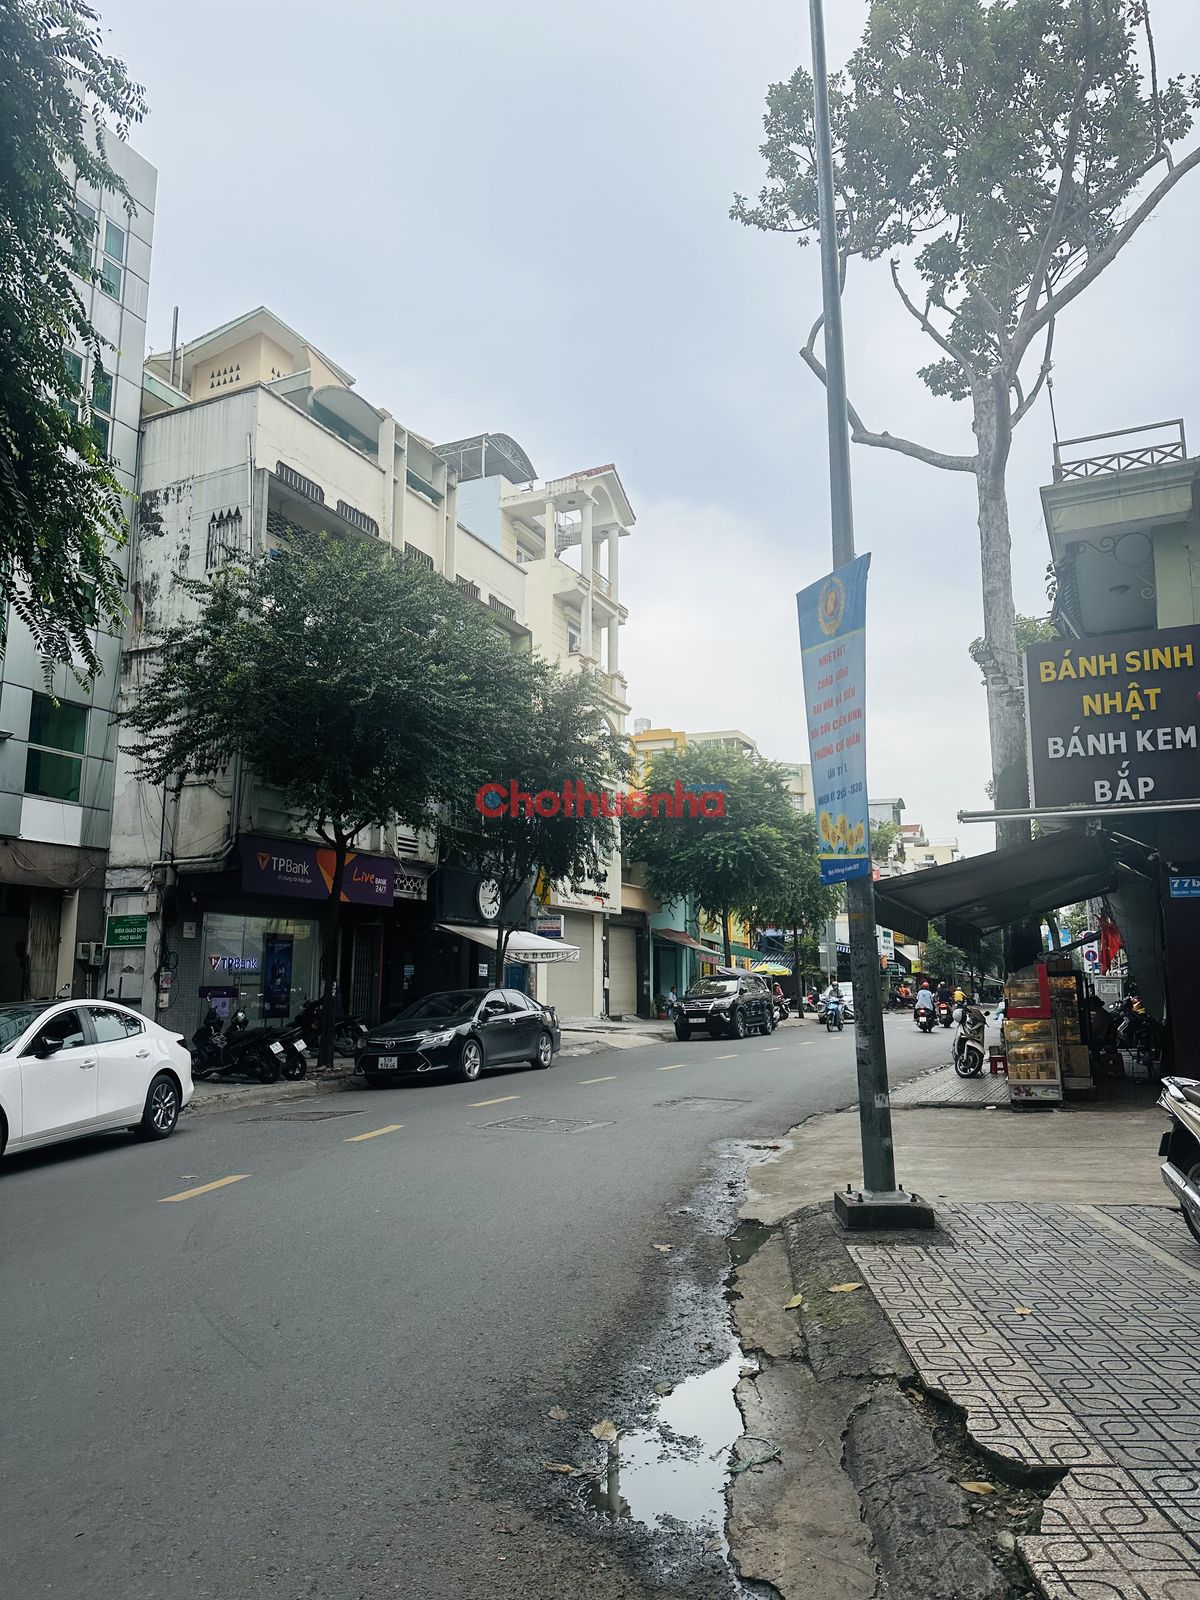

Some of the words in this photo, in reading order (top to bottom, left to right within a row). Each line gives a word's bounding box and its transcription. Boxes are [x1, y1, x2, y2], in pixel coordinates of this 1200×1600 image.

[1039, 649, 1118, 683] BÁNH
[1125, 644, 1194, 673] SINH
[1082, 681, 1161, 720] NHẬT
[1047, 726, 1127, 759] BÁNH
[1136, 725, 1197, 752] KEM
[1094, 760, 1155, 803] BẮP
[271, 856, 310, 876] TPBank
[353, 867, 375, 884] Live
[375, 877, 388, 886] BANK
[375, 885, 387, 893] 24/7
[223, 957, 259, 970] TPBank
